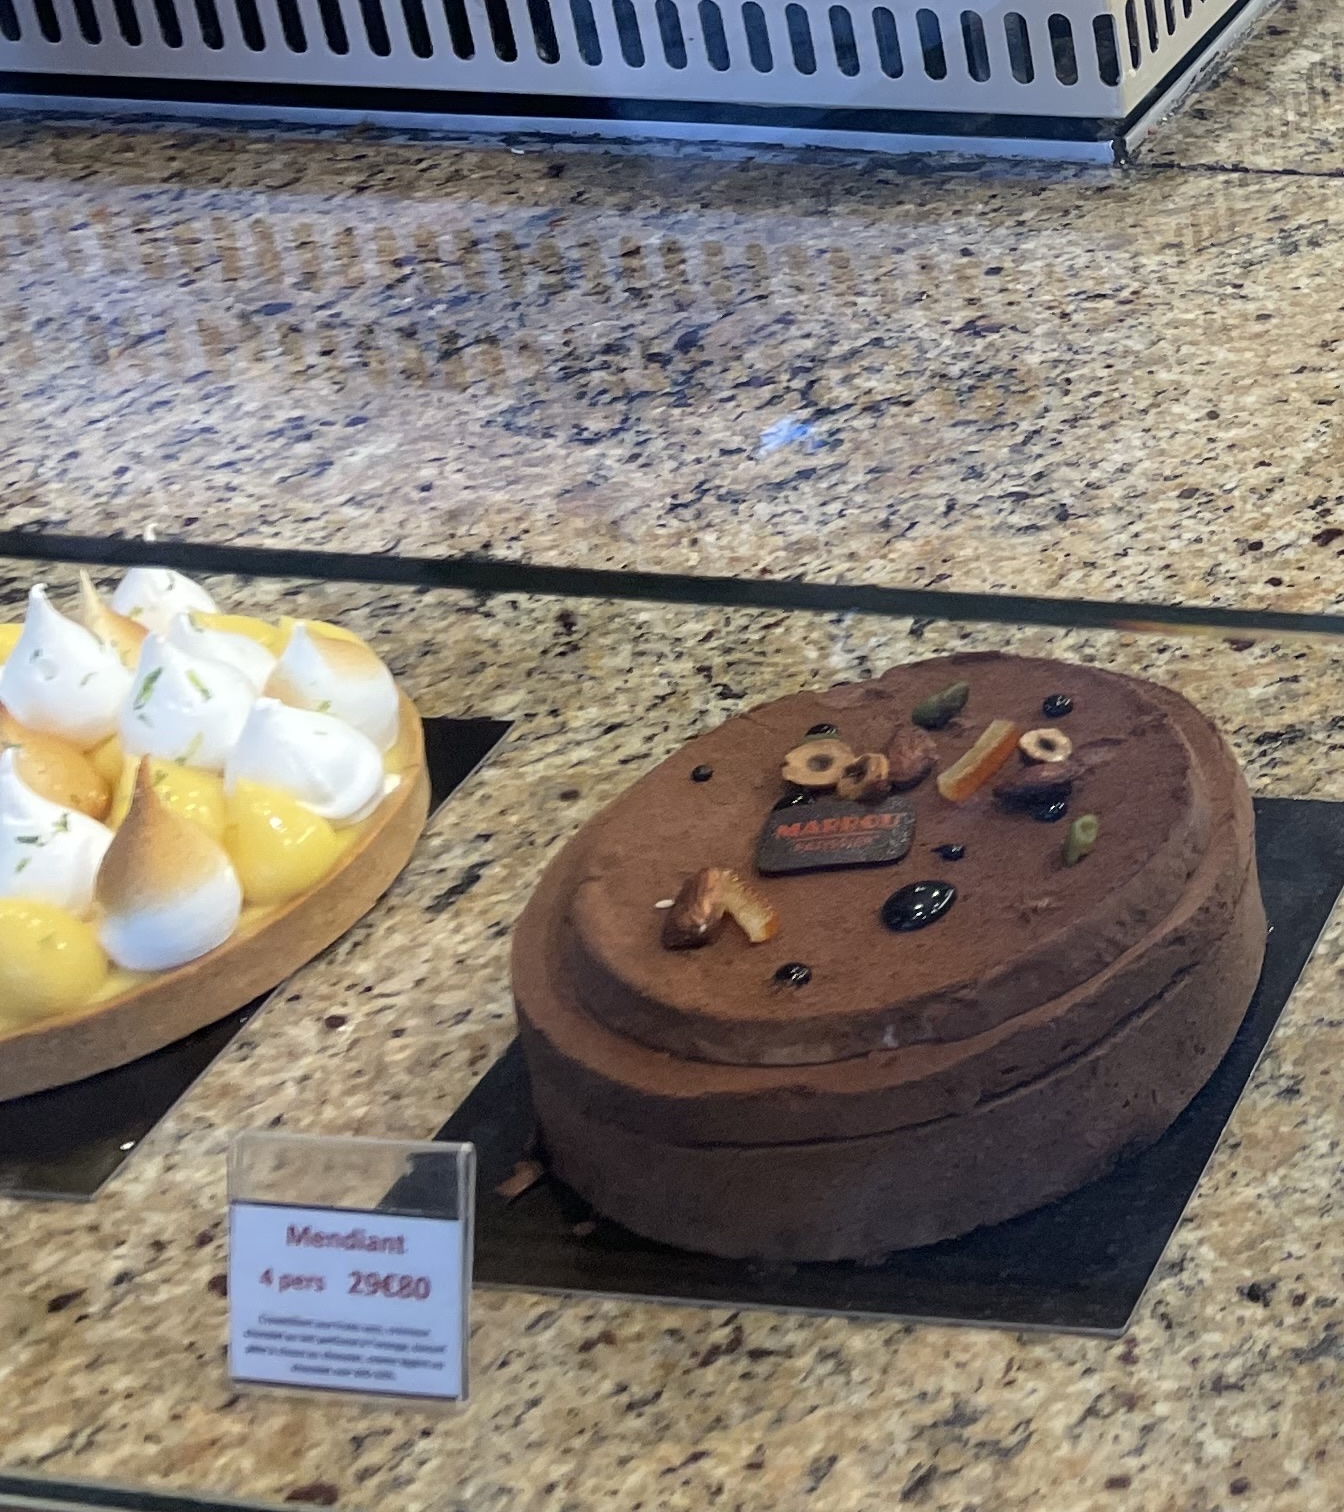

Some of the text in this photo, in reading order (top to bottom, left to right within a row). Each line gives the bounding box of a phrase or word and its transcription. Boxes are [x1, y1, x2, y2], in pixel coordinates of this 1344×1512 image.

[286, 1223, 405, 1255] Mendiant
[258, 1268, 432, 1301] 4 pers 29€80
